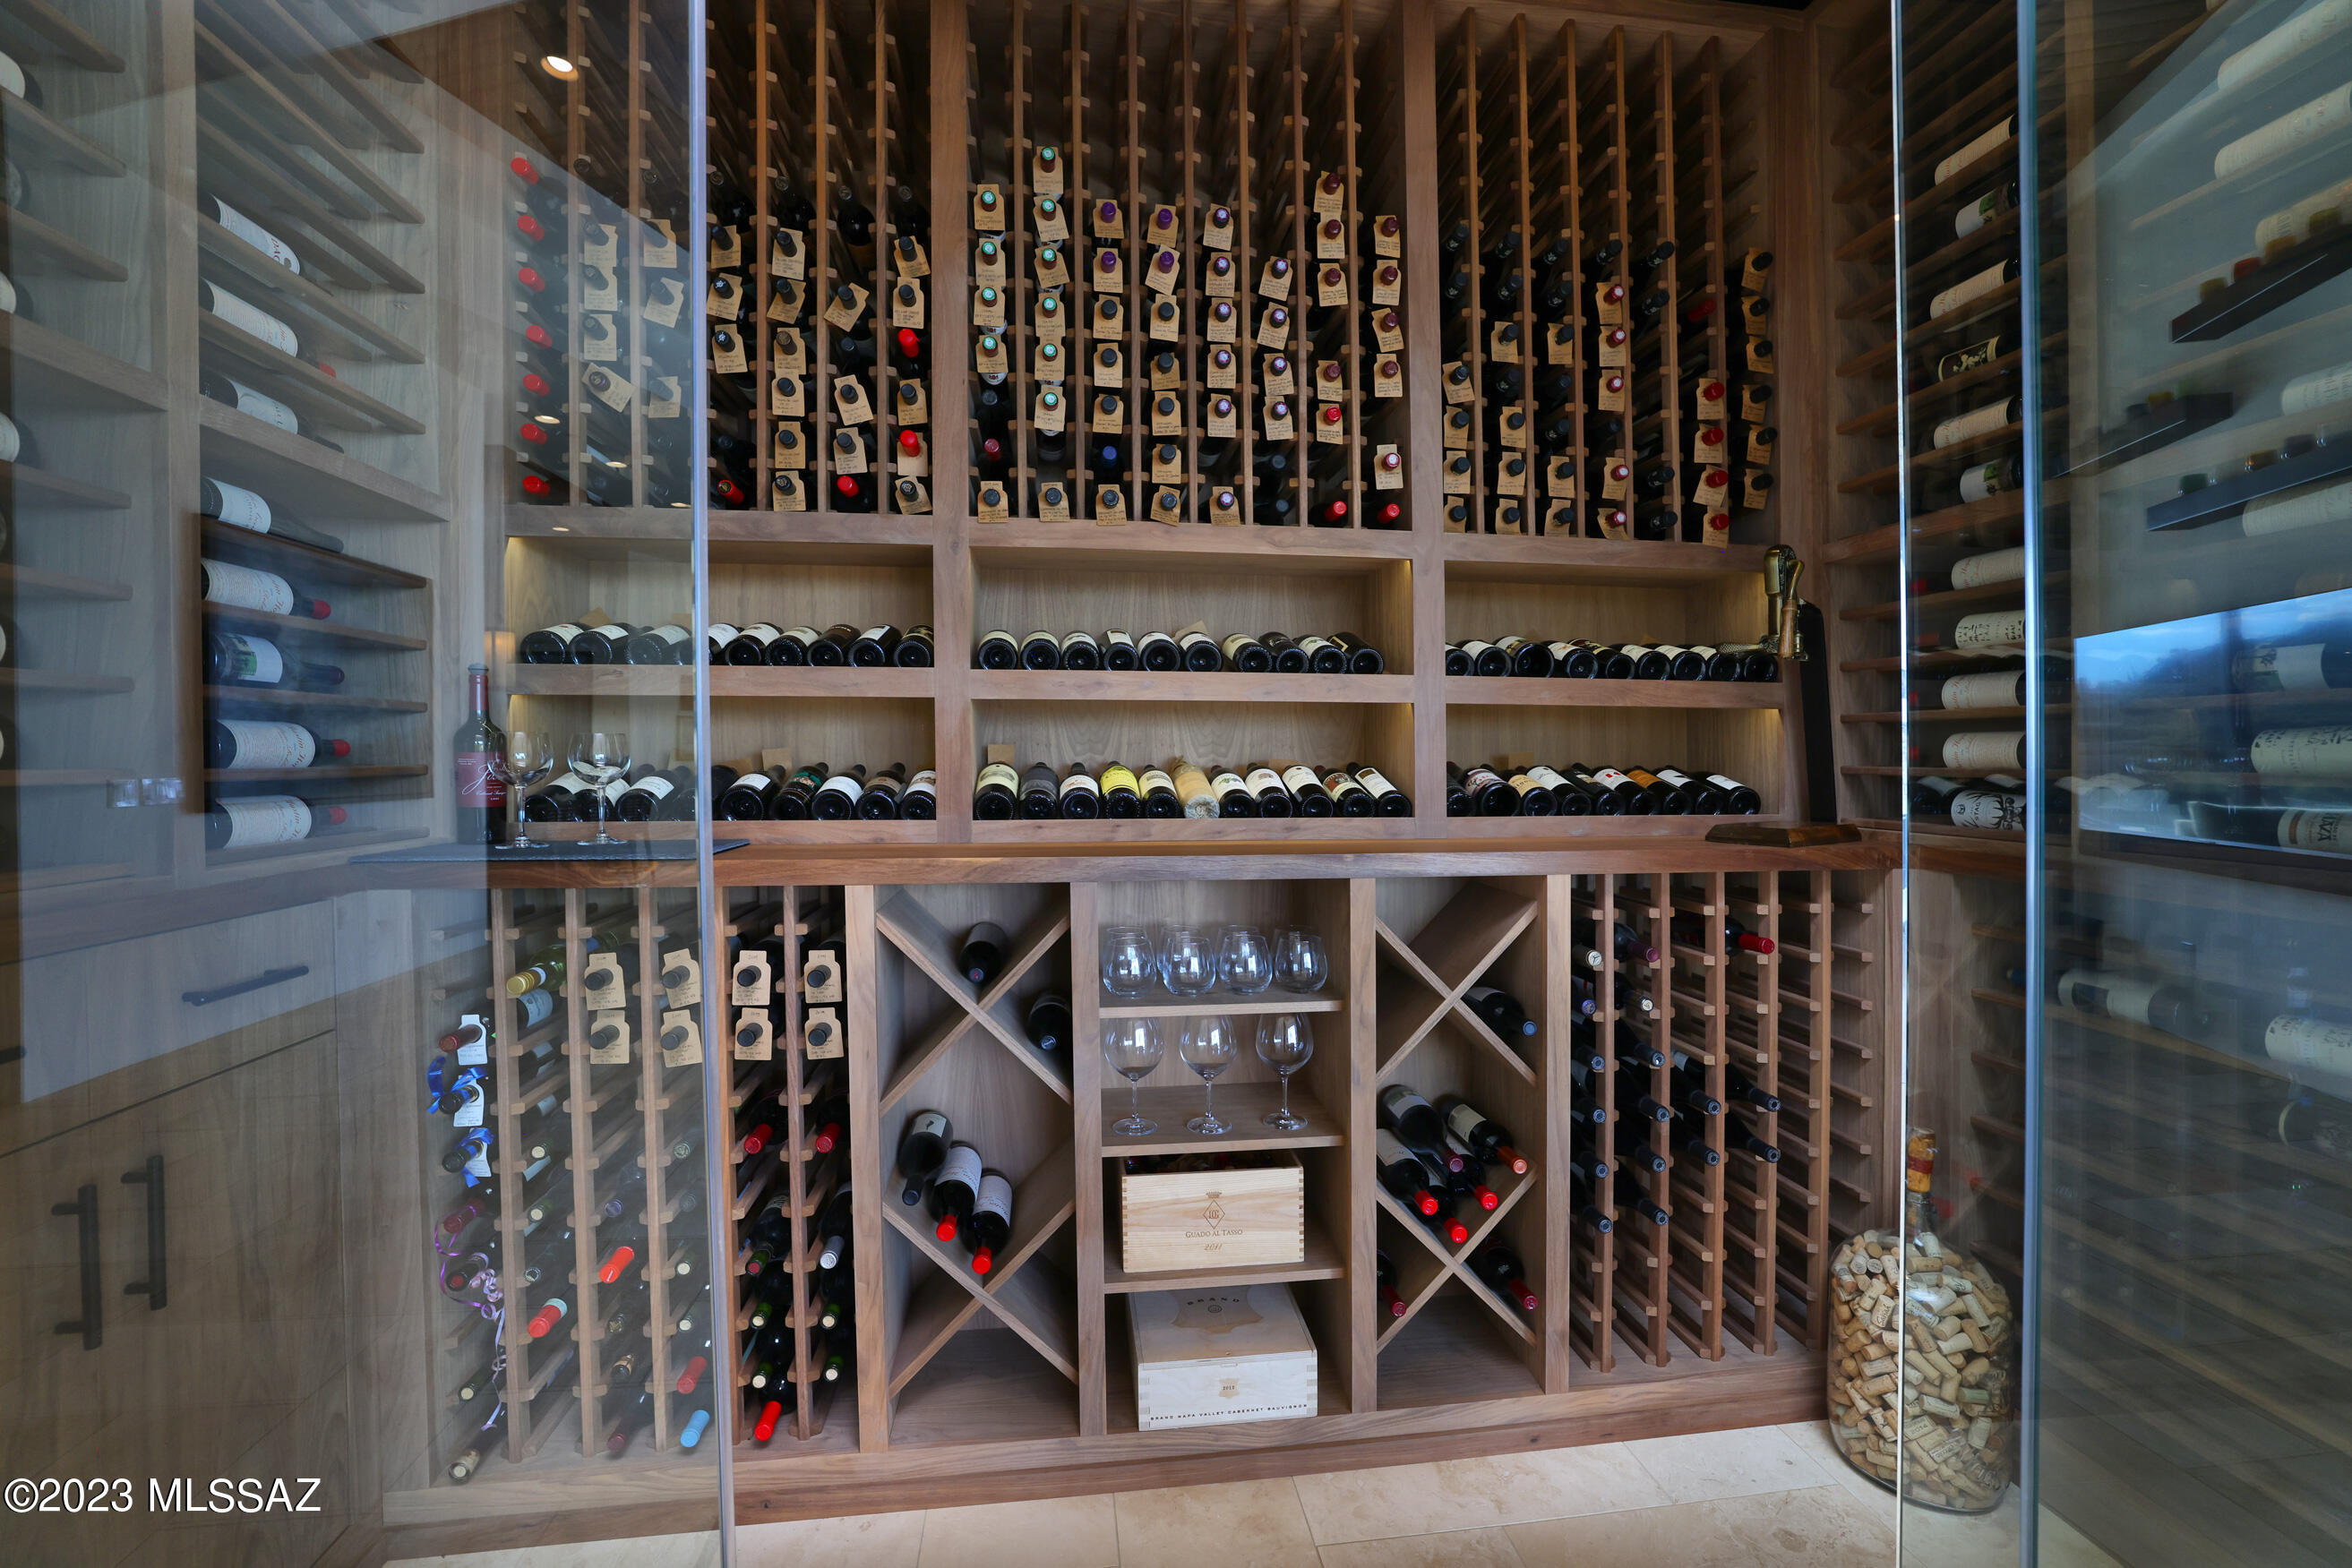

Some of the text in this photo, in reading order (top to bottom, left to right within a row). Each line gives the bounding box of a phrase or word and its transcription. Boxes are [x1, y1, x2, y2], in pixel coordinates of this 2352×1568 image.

[1222, 1229, 1243, 1237] TASSO
[1227, 1407, 1264, 1415] CABERNET
[1267, 1403, 1308, 1411] SAUVIGNON
